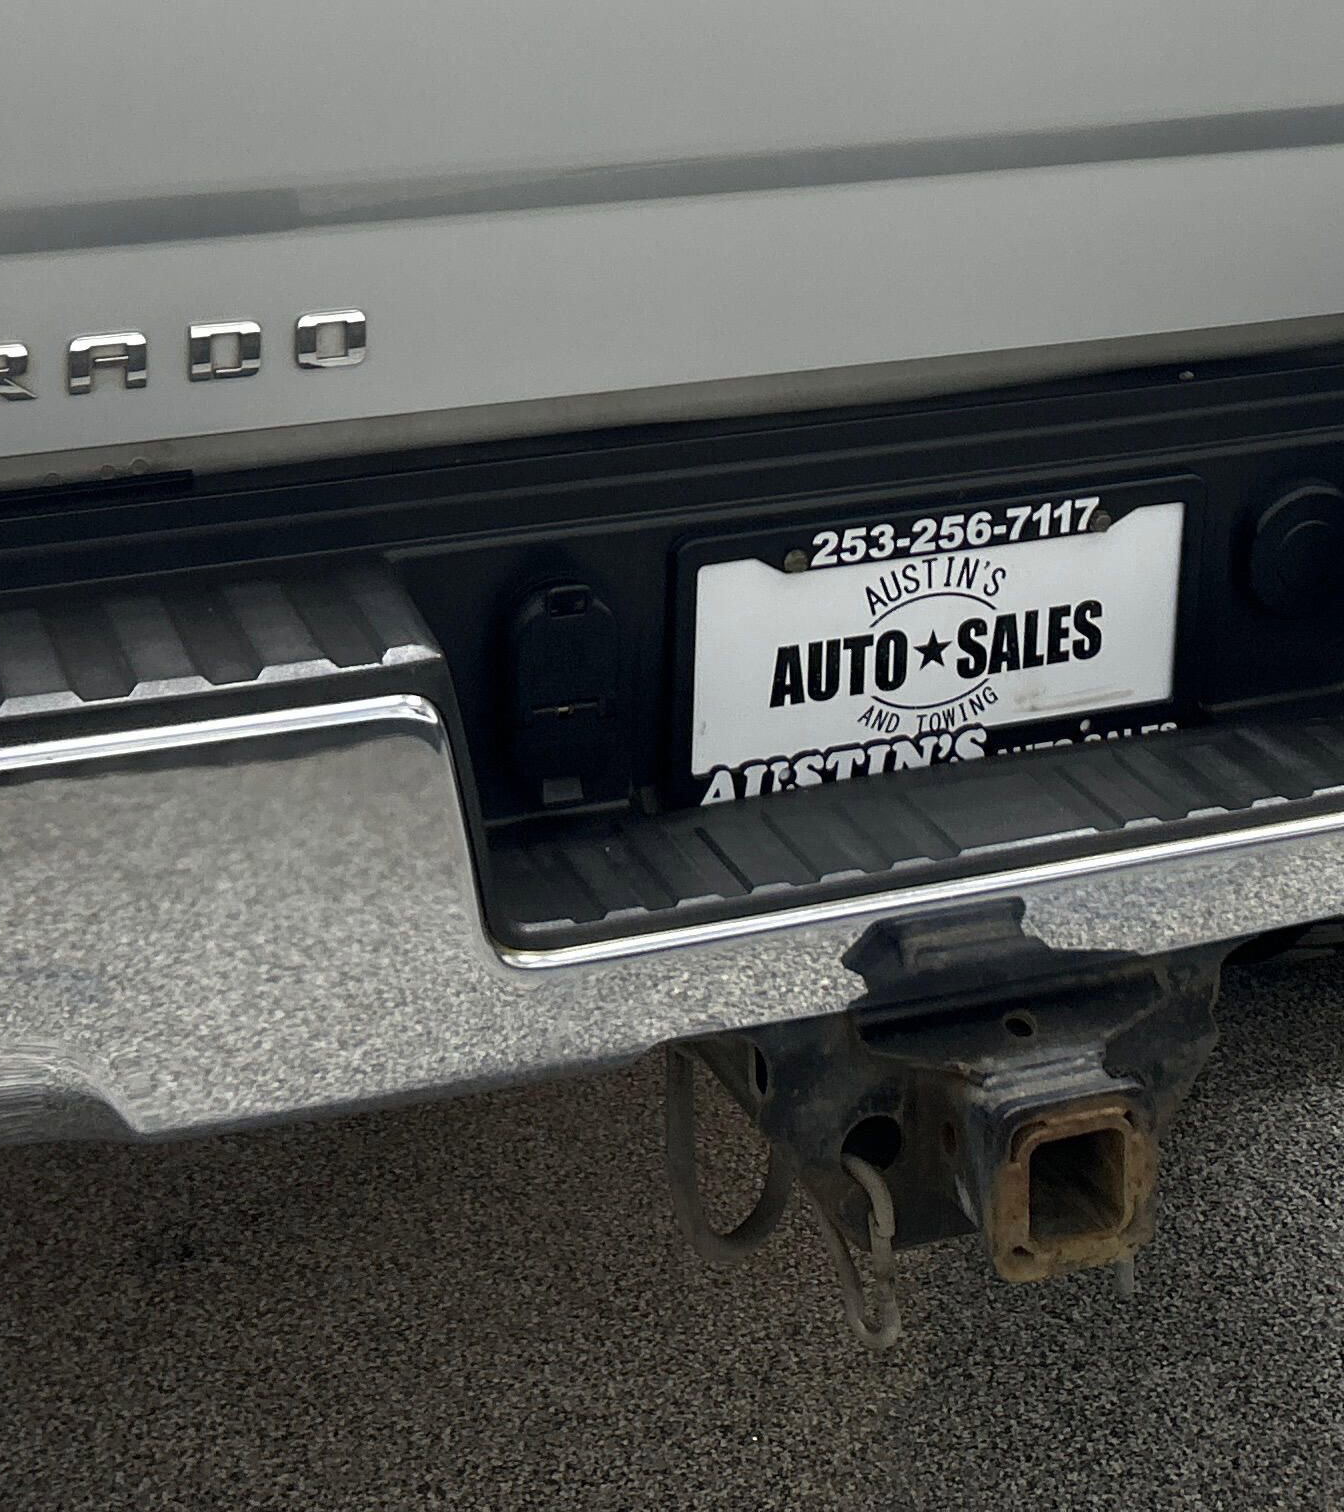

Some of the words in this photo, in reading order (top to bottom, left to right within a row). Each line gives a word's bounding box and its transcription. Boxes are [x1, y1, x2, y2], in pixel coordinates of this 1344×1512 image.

[811, 496, 1101, 568] 253-256-7117
[864, 555, 1007, 616] AUSTIN'S
[768, 628, 908, 709] AUTO
[956, 599, 1104, 680] SALES
[857, 703, 901, 734] AND
[916, 685, 1000, 734] TOWING
[699, 725, 988, 807] AUSTIN'S
